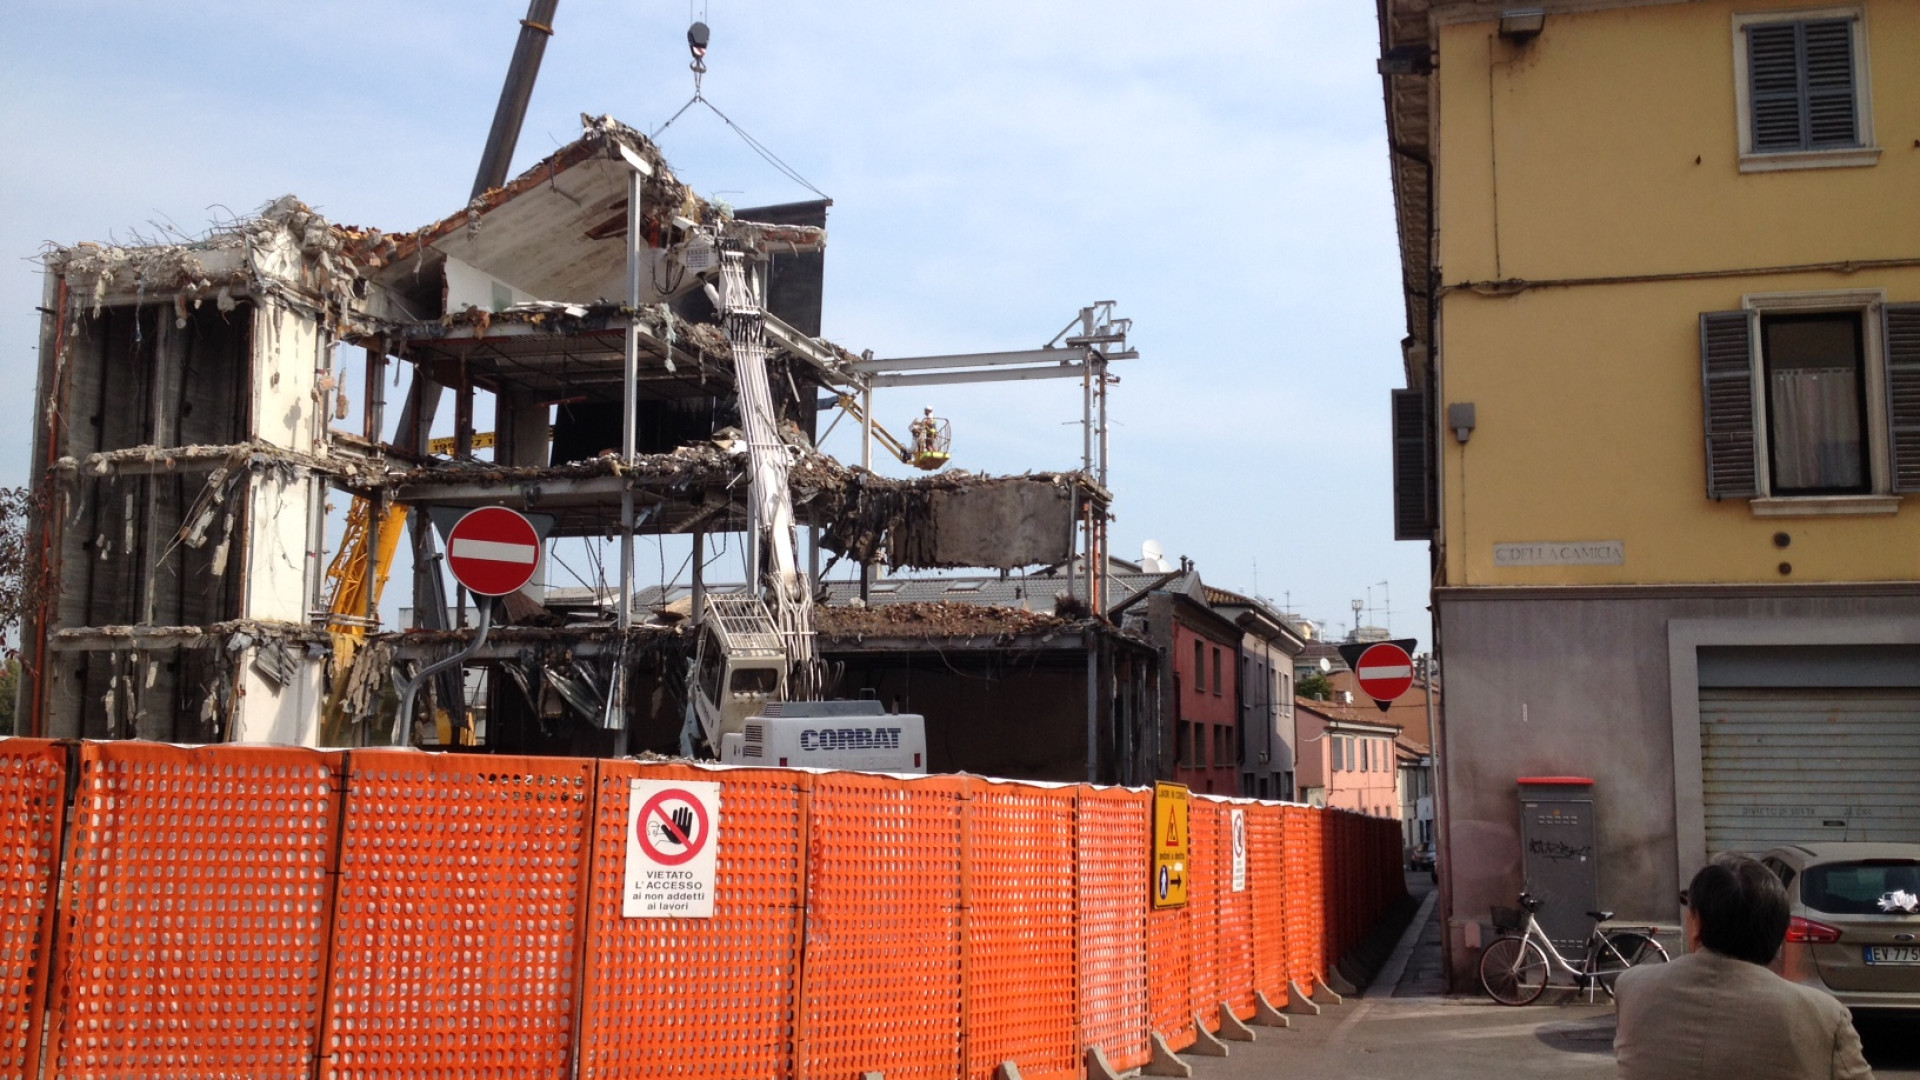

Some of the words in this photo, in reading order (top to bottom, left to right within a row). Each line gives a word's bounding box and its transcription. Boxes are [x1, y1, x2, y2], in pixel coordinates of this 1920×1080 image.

[800, 727, 902, 752] CORBAT
[646, 871, 693, 879] VIETATO
[632, 892, 642, 900] ai
[666, 892, 705, 900] addetti
[647, 902, 656, 910] ai
[659, 902, 689, 910] lavori
[1873, 947, 1889, 961] EV
[1893, 947, 1920, 961] 775
